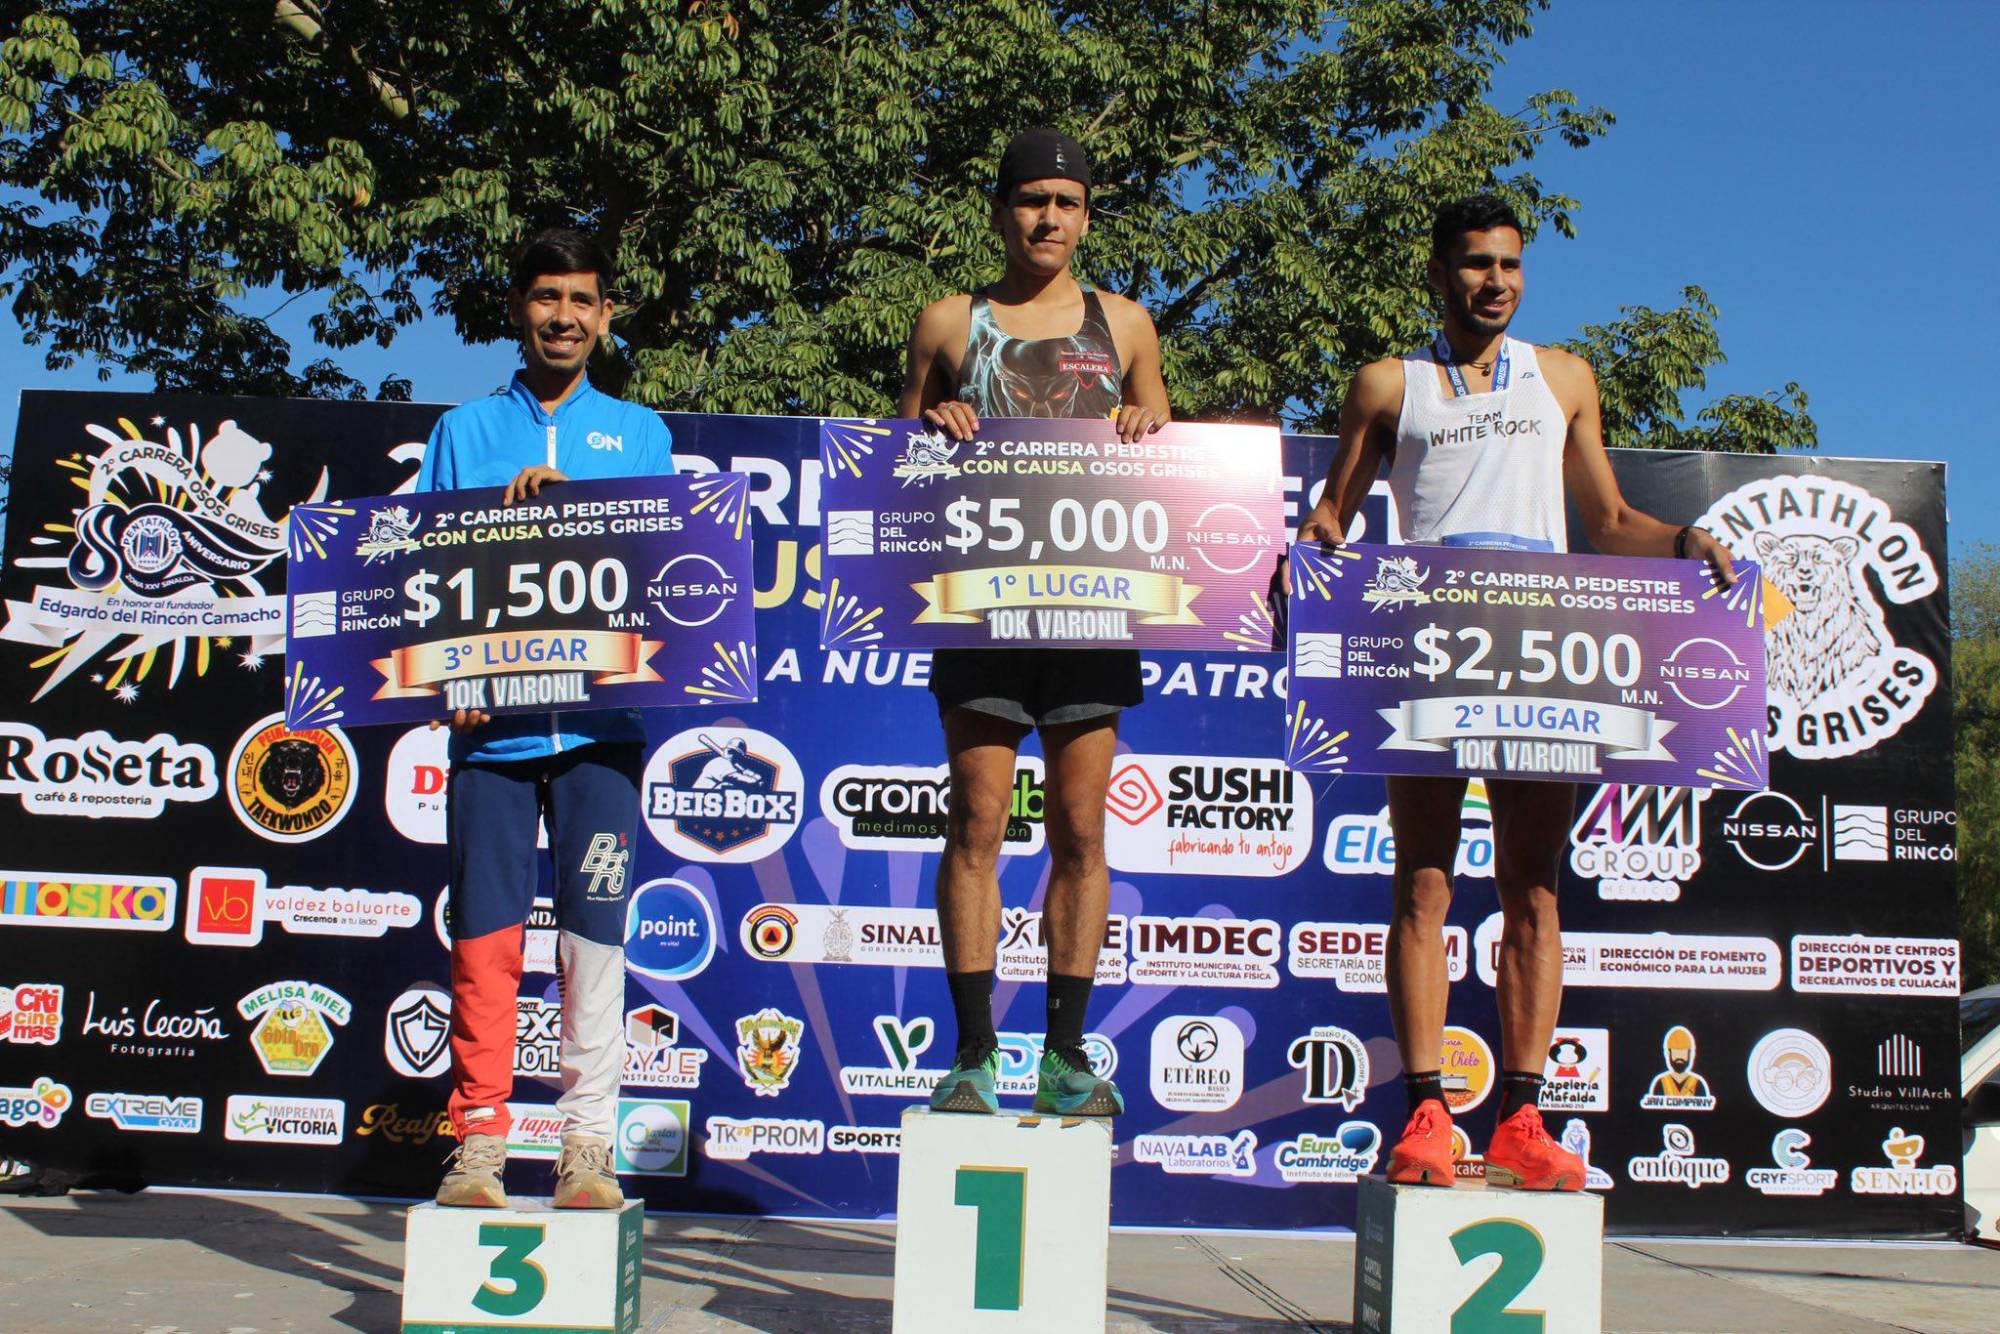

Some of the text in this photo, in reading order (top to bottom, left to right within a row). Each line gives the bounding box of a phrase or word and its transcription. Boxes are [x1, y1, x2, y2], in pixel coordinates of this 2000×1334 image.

[1467, 412, 1502, 425] TEAM
[1430, 419, 1541, 447] WHITE ROCK
[975, 440, 1099, 458] 2° CARRERA
[962, 458, 1010, 475] CON
[1013, 459, 1085, 476] CAUSA
[1089, 461, 1146, 477] OSOS
[100, 447, 281, 540] 2° CARRERA OSOS GRISES
[435, 498, 670, 528] 2° CARRERA PEDESTRE
[879, 512, 936, 525] GRUPO
[123, 517, 179, 548] PENTATHLON
[422, 515, 684, 549] CON CAUSA OSOS GRISES
[879, 526, 907, 538] DEL
[943, 495, 1170, 561] $5,000
[879, 536, 942, 553] RINCÓN
[1186, 529, 1272, 547] NISSAN
[1709, 487, 1926, 592] NTATHLON
[181, 530, 251, 571] ANIVERSARIO
[1149, 555, 1191, 571] M.N.
[161, 575, 195, 589] SINALOA
[646, 582, 738, 599] NISSAN
[987, 572, 1132, 601] 1° LUGAR
[1445, 569, 1681, 596] 2° CARRERA PEDESTRE
[341, 587, 396, 604] GRUPO
[402, 556, 629, 630] $1,500
[1432, 587, 1696, 615] CON CAUSA OSOS GRISES
[39, 597, 282, 626] Edgardo del Rincón Camacho
[106, 597, 215, 611] En honor al fundador
[341, 604, 369, 618] DEL
[341, 613, 401, 632] RINCÓN
[607, 611, 651, 630] M.N.
[986, 608, 1134, 641] 10K VARONIL
[1347, 636, 1404, 650] GRUPO
[444, 637, 588, 673] 3° LUGAR
[1347, 650, 1376, 663] DEL
[1412, 622, 1642, 691] $2,500
[1347, 662, 1411, 679] RINCÓN
[1659, 663, 1751, 682] NISSAN
[442, 671, 591, 712] 10K VARONIL
[1620, 688, 1664, 706] M.N.
[1797, 659, 1925, 747] GRISES
[1453, 704, 1601, 735] 2° LUGAR
[1453, 738, 1604, 776] 10K VARONIL
[1168, 765, 1294, 804] SUSHI
[34, 791, 66, 803] café
[68, 792, 79, 803] &
[247, 795, 333, 832] TAEKWONDO
[1166, 804, 1294, 832] FACTORY
[857, 820, 938, 835] medimos
[1723, 823, 1818, 840] NISSAN
[1894, 828, 1926, 841] DEL
[1167, 832, 1294, 870] fabricando tu antojo
[1894, 843, 1957, 861] RINCÓ
[1576, 851, 1697, 875] GROUP
[0, 880, 166, 921] IOSKO
[265, 897, 412, 916] valdez baluarte
[293, 914, 338, 924] Crecemos
[1138, 923, 1273, 957] IMDEC
[1798, 939, 1957, 957] DIRECCIÓN DE CENTROS
[860, 946, 918, 954] GOBIERNO
[1002, 954, 1047, 965] Instituto
[1600, 946, 1677, 961] DIRECCIÓN
[1679, 949, 1698, 962] DE
[1700, 950, 1768, 963] FOMENTO
[1001, 967, 1036, 977] Cultura
[1146, 960, 1262, 971] INSTITUTO MUNICIPAL DEL
[1297, 957, 1382, 971] SECRETARÍA DE
[1600, 961, 1768, 977] ECONÓMICO PARA LA MUJER
[1798, 955, 1957, 976] DEPORTIVOS Y
[1136, 969, 1272, 981] DEPORTE Y LA CULTURA FÍSICA
[1798, 975, 1957, 990] RECREATIVOS DE CULIACÁN
[15, 987, 60, 1014] Citi
[243, 986, 346, 1019] MELISA MIEL
[14, 1012, 58, 1026] cine
[82, 990, 231, 1040] Luis Ceceña
[13, 1024, 57, 1041] mas
[1163, 1064, 1231, 1086] ETÉREO
[1540, 1090, 1597, 1103] Mafalda
[1849, 1085, 1952, 1100] Studio VillArch
[91, 1097, 199, 1118] EXTREME
[268, 1104, 335, 1120] IMPRENTA
[1665, 1098, 1713, 1108] COMPANY
[157, 1117, 197, 1129] GYM
[265, 1117, 338, 1136] VICTORIA
[752, 1125, 819, 1147] PROM
[1300, 1137, 1341, 1154] Euro
[1140, 1141, 1229, 1157] NAVALAB
[1168, 1156, 1231, 1168] Laboratorios
[1279, 1146, 1369, 1172] Cambridge
[1286, 1170, 1322, 1178] Instituto
[1632, 1154, 1726, 1186] enfoque
[1750, 1171, 1835, 1186] CRYFSPORT
[954, 1165, 1028, 1311] 1
[471, 1221, 548, 1317] 3
[1448, 1217, 1547, 1334] 2
